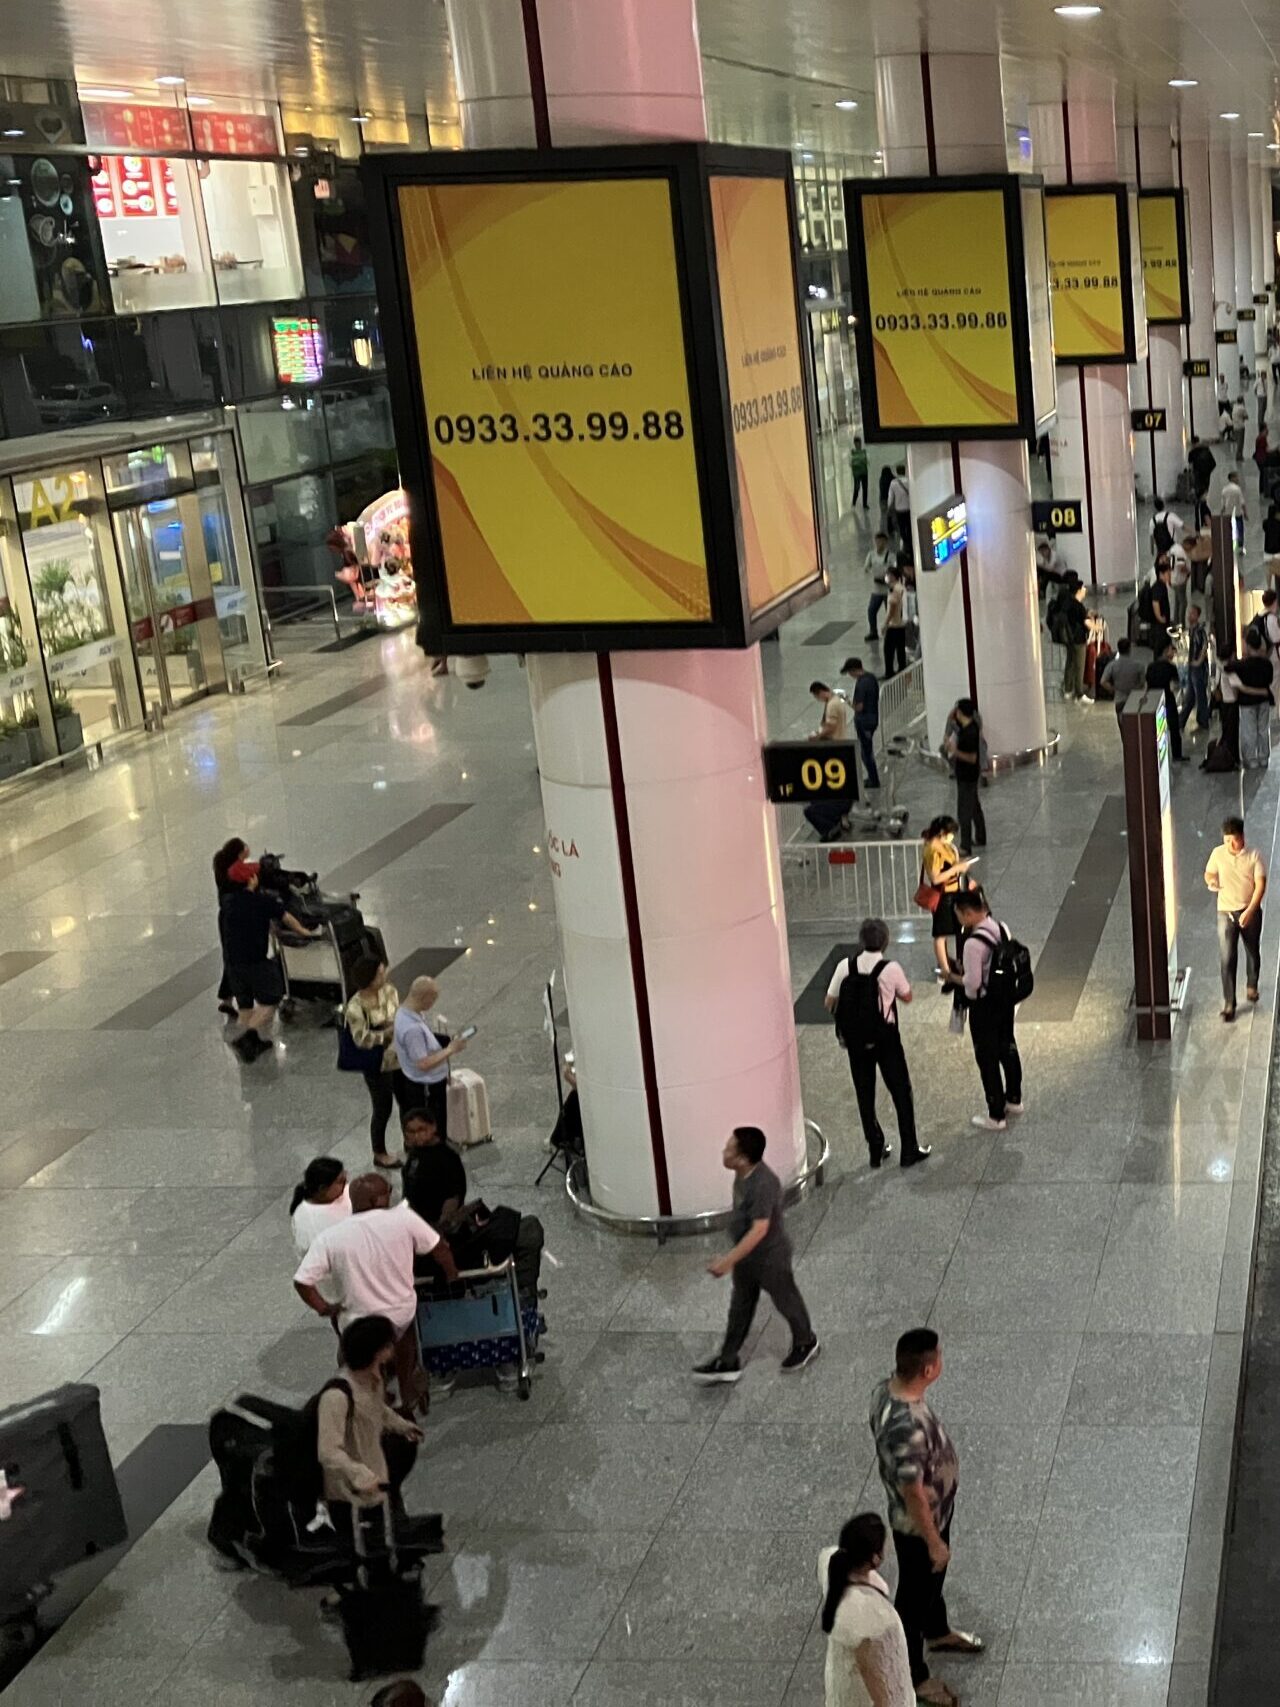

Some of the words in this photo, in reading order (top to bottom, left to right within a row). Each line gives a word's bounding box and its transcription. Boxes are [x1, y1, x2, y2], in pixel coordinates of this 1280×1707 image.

[875, 311, 1008, 332] 0933.33.99.88
[471, 364, 508, 381] LIÊN
[511, 363, 533, 382] HỆ
[434, 410, 685, 445] 0933.33.99.88
[1144, 412, 1163, 429] 07
[30, 474, 80, 530] A2
[1051, 507, 1076, 528] 08
[801, 758, 846, 791] 09
